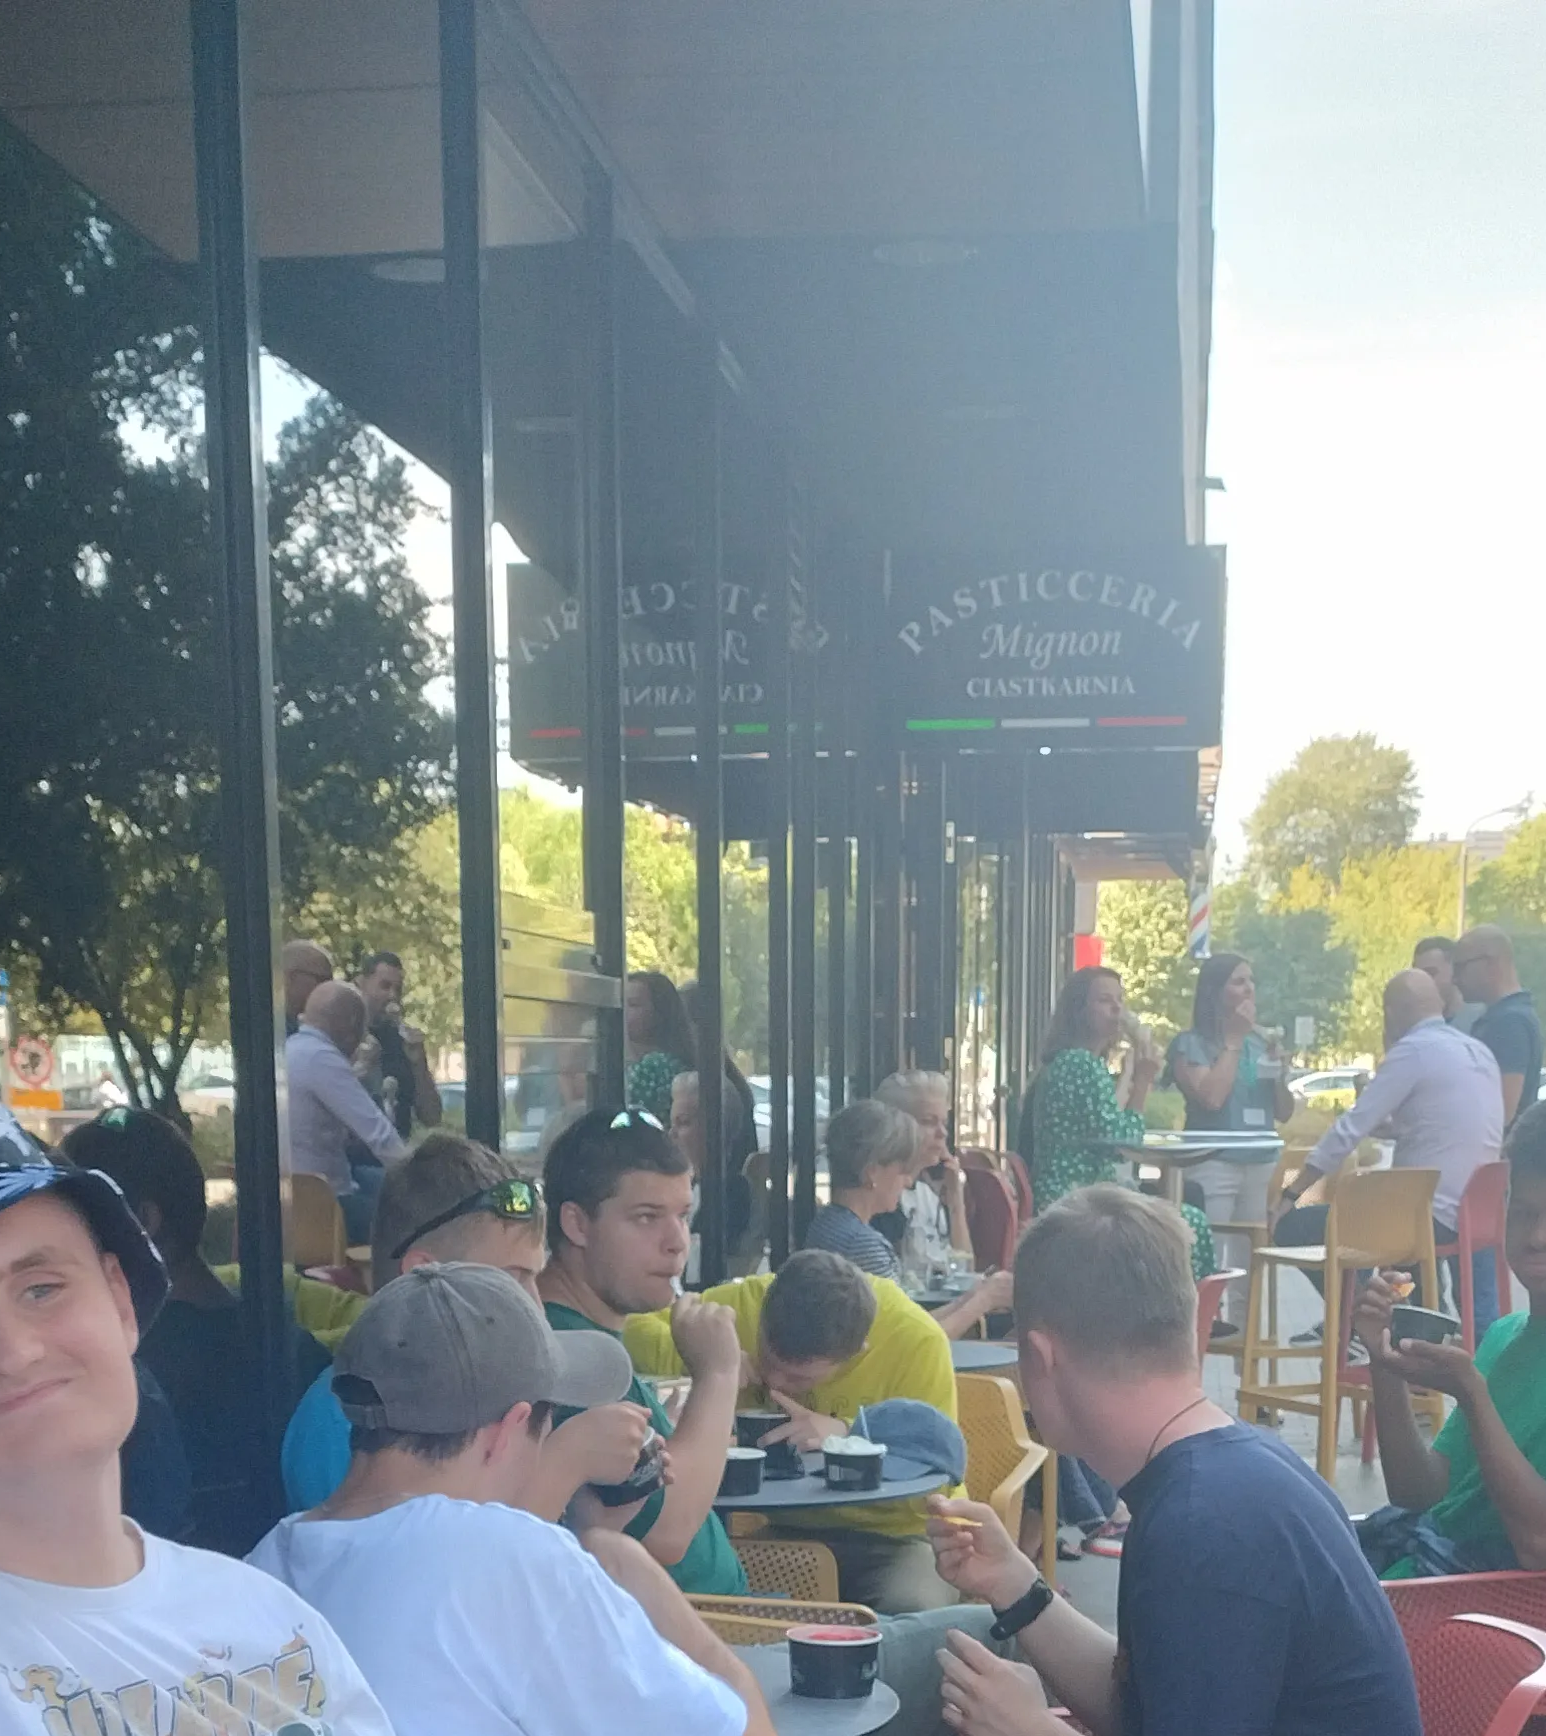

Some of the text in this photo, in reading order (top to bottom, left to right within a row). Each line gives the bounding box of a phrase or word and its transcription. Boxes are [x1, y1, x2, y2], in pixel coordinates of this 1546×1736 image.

[898, 569, 1201, 655] PASTICCERIA
[979, 621, 1123, 671] Mignon
[966, 675, 1136, 699] CIASTKARNIA
